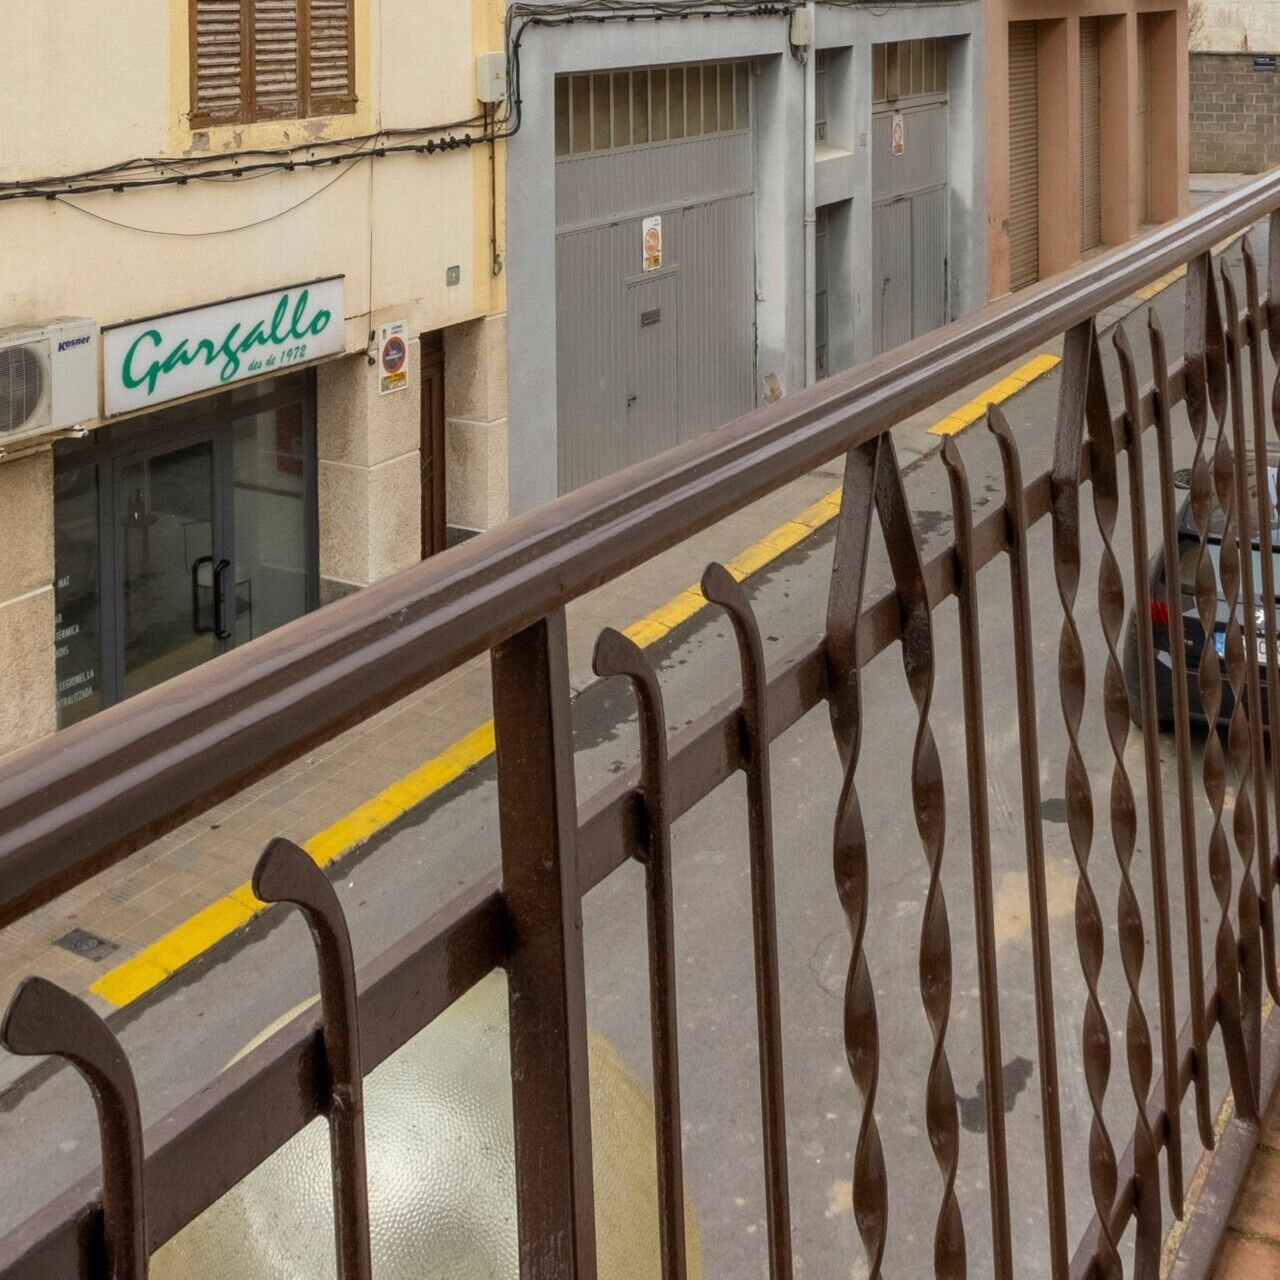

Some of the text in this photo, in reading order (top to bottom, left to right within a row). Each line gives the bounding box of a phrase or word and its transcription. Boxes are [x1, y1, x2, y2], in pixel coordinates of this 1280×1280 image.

[58, 336, 91, 352] Kosner
[122, 289, 331, 395] Gargallo
[248, 344, 307, 371] des de 1972
